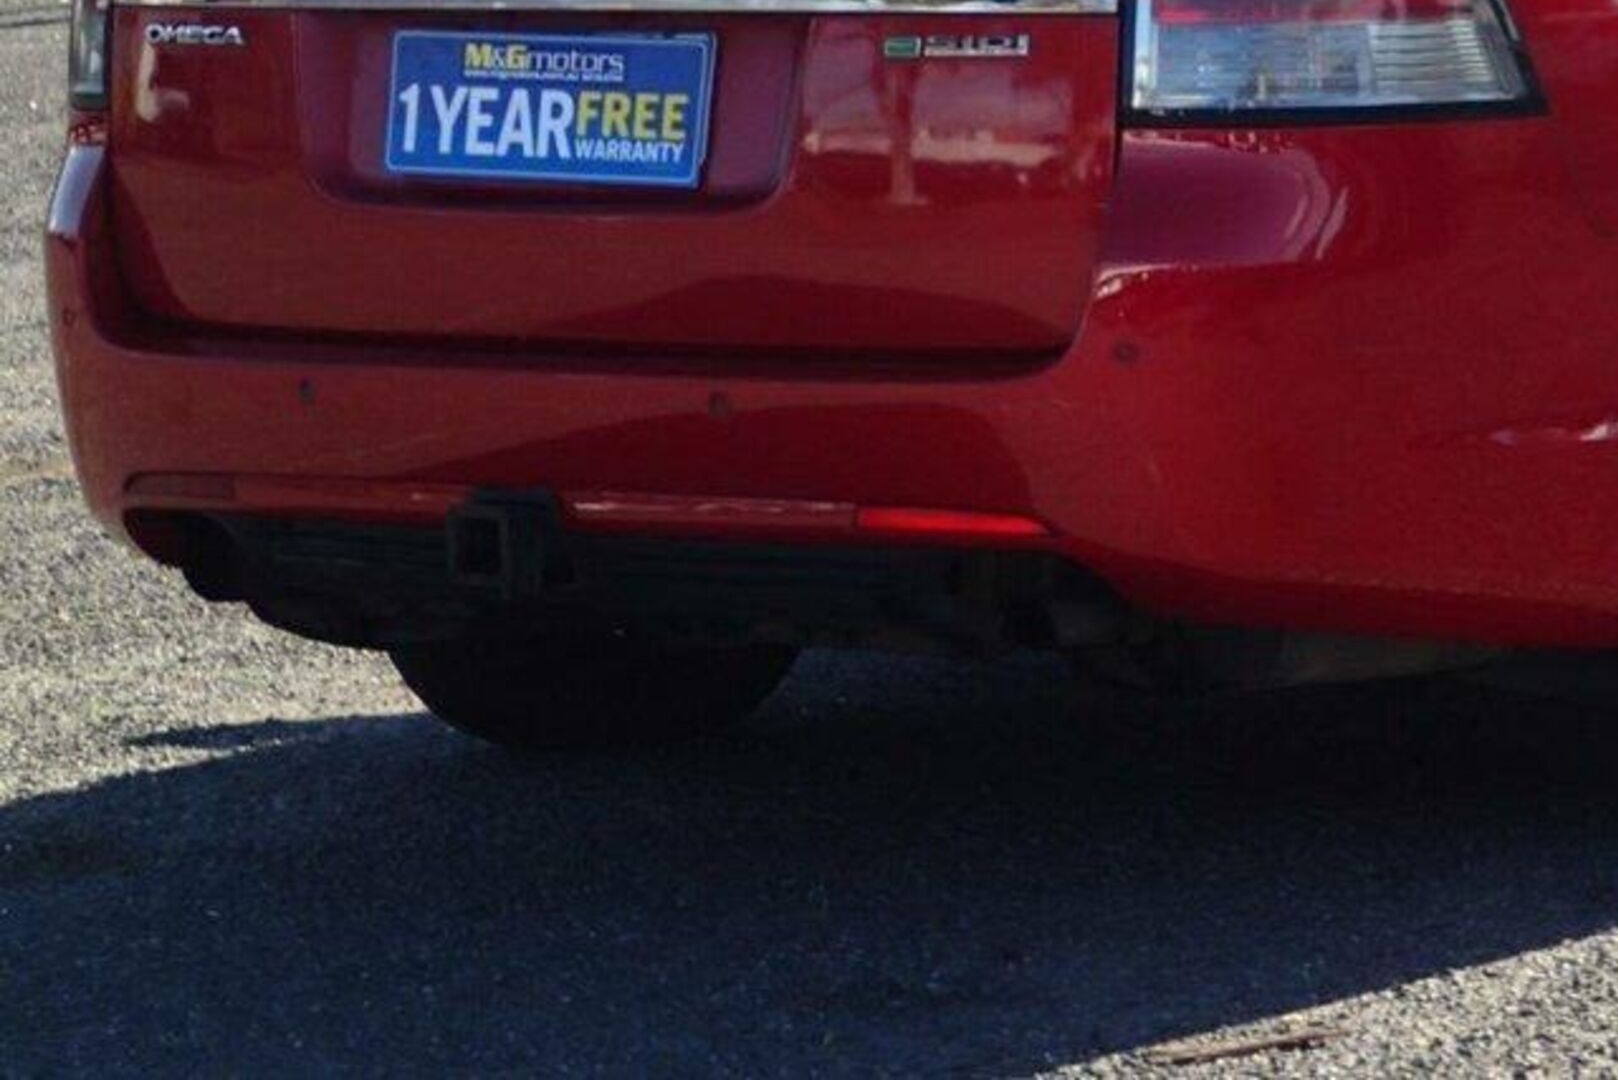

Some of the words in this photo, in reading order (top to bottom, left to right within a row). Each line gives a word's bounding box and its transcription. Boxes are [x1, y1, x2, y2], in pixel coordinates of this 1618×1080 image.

[145, 23, 245, 45] OMEGA
[399, 83, 421, 154] 1
[430, 85, 575, 160] YEAR
[575, 91, 690, 140] FREE
[575, 139, 685, 164] WARRANTY
